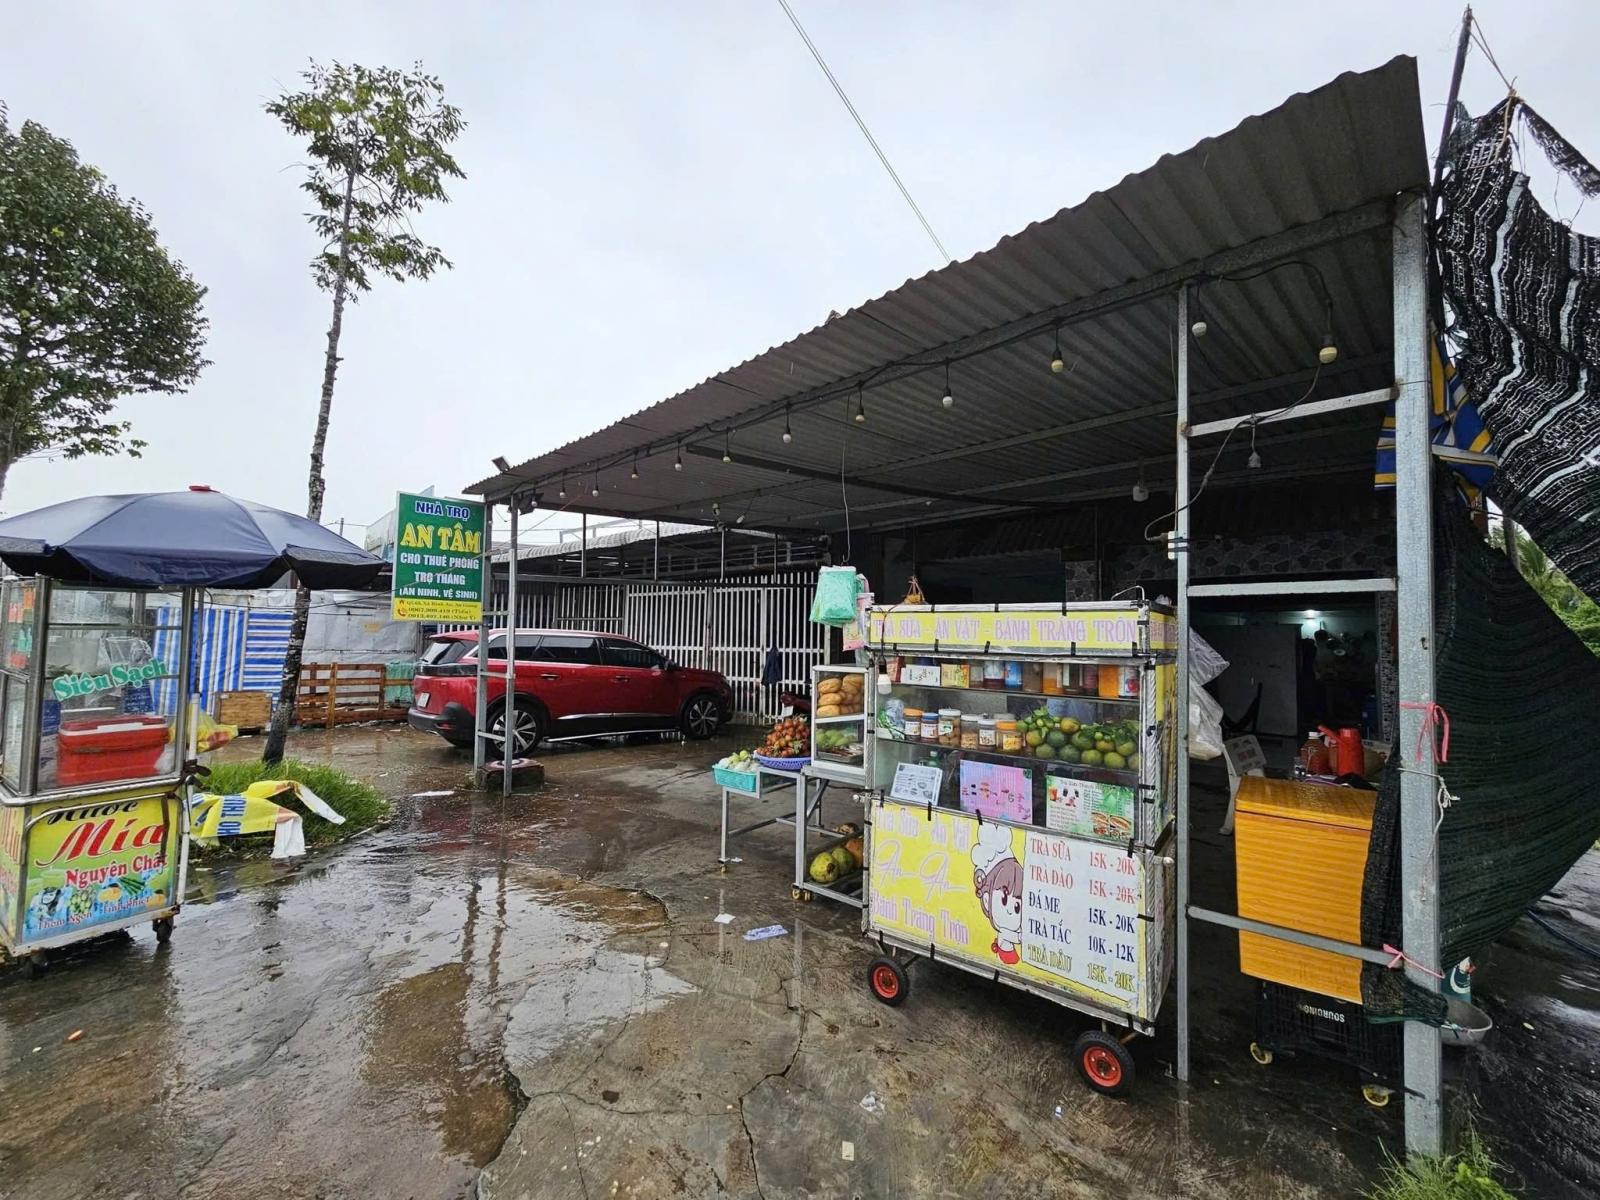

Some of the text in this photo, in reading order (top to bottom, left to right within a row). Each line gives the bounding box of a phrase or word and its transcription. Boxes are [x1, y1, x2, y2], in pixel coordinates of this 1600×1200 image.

[446, 505, 470, 521] TRỌ
[400, 521, 481, 553] AN TÂM
[400, 552, 479, 569] CHO THUÊ PHÒNG
[400, 587, 478, 599] (AN NINH, VỆ SINH)
[414, 571, 466, 585] TRỌ THÁNG
[52, 672, 113, 702] Siêu
[110, 657, 169, 688] Sạch
[34, 818, 168, 868] Mía
[1030, 836, 1049, 857] TRÀ
[1089, 851, 1107, 870] 15K
[1116, 856, 1136, 876] 20K
[65, 860, 129, 889] Nguyên
[1030, 863, 1049, 883] TRÀ
[1089, 879, 1107, 898] 15K
[1115, 885, 1136, 905] 20K
[1028, 889, 1042, 910] ĐÁ
[1044, 895, 1060, 914] ME
[1088, 907, 1106, 927] 15K
[1115, 913, 1135, 934] 20K
[1028, 916, 1048, 938] TRÀ
[1050, 919, 1072, 944] TẮC
[1088, 935, 1106, 955] 10K
[1116, 943, 1135, 963] 12K
[1087, 962, 1108, 984] 15K
[1115, 970, 1136, 993] 20K
